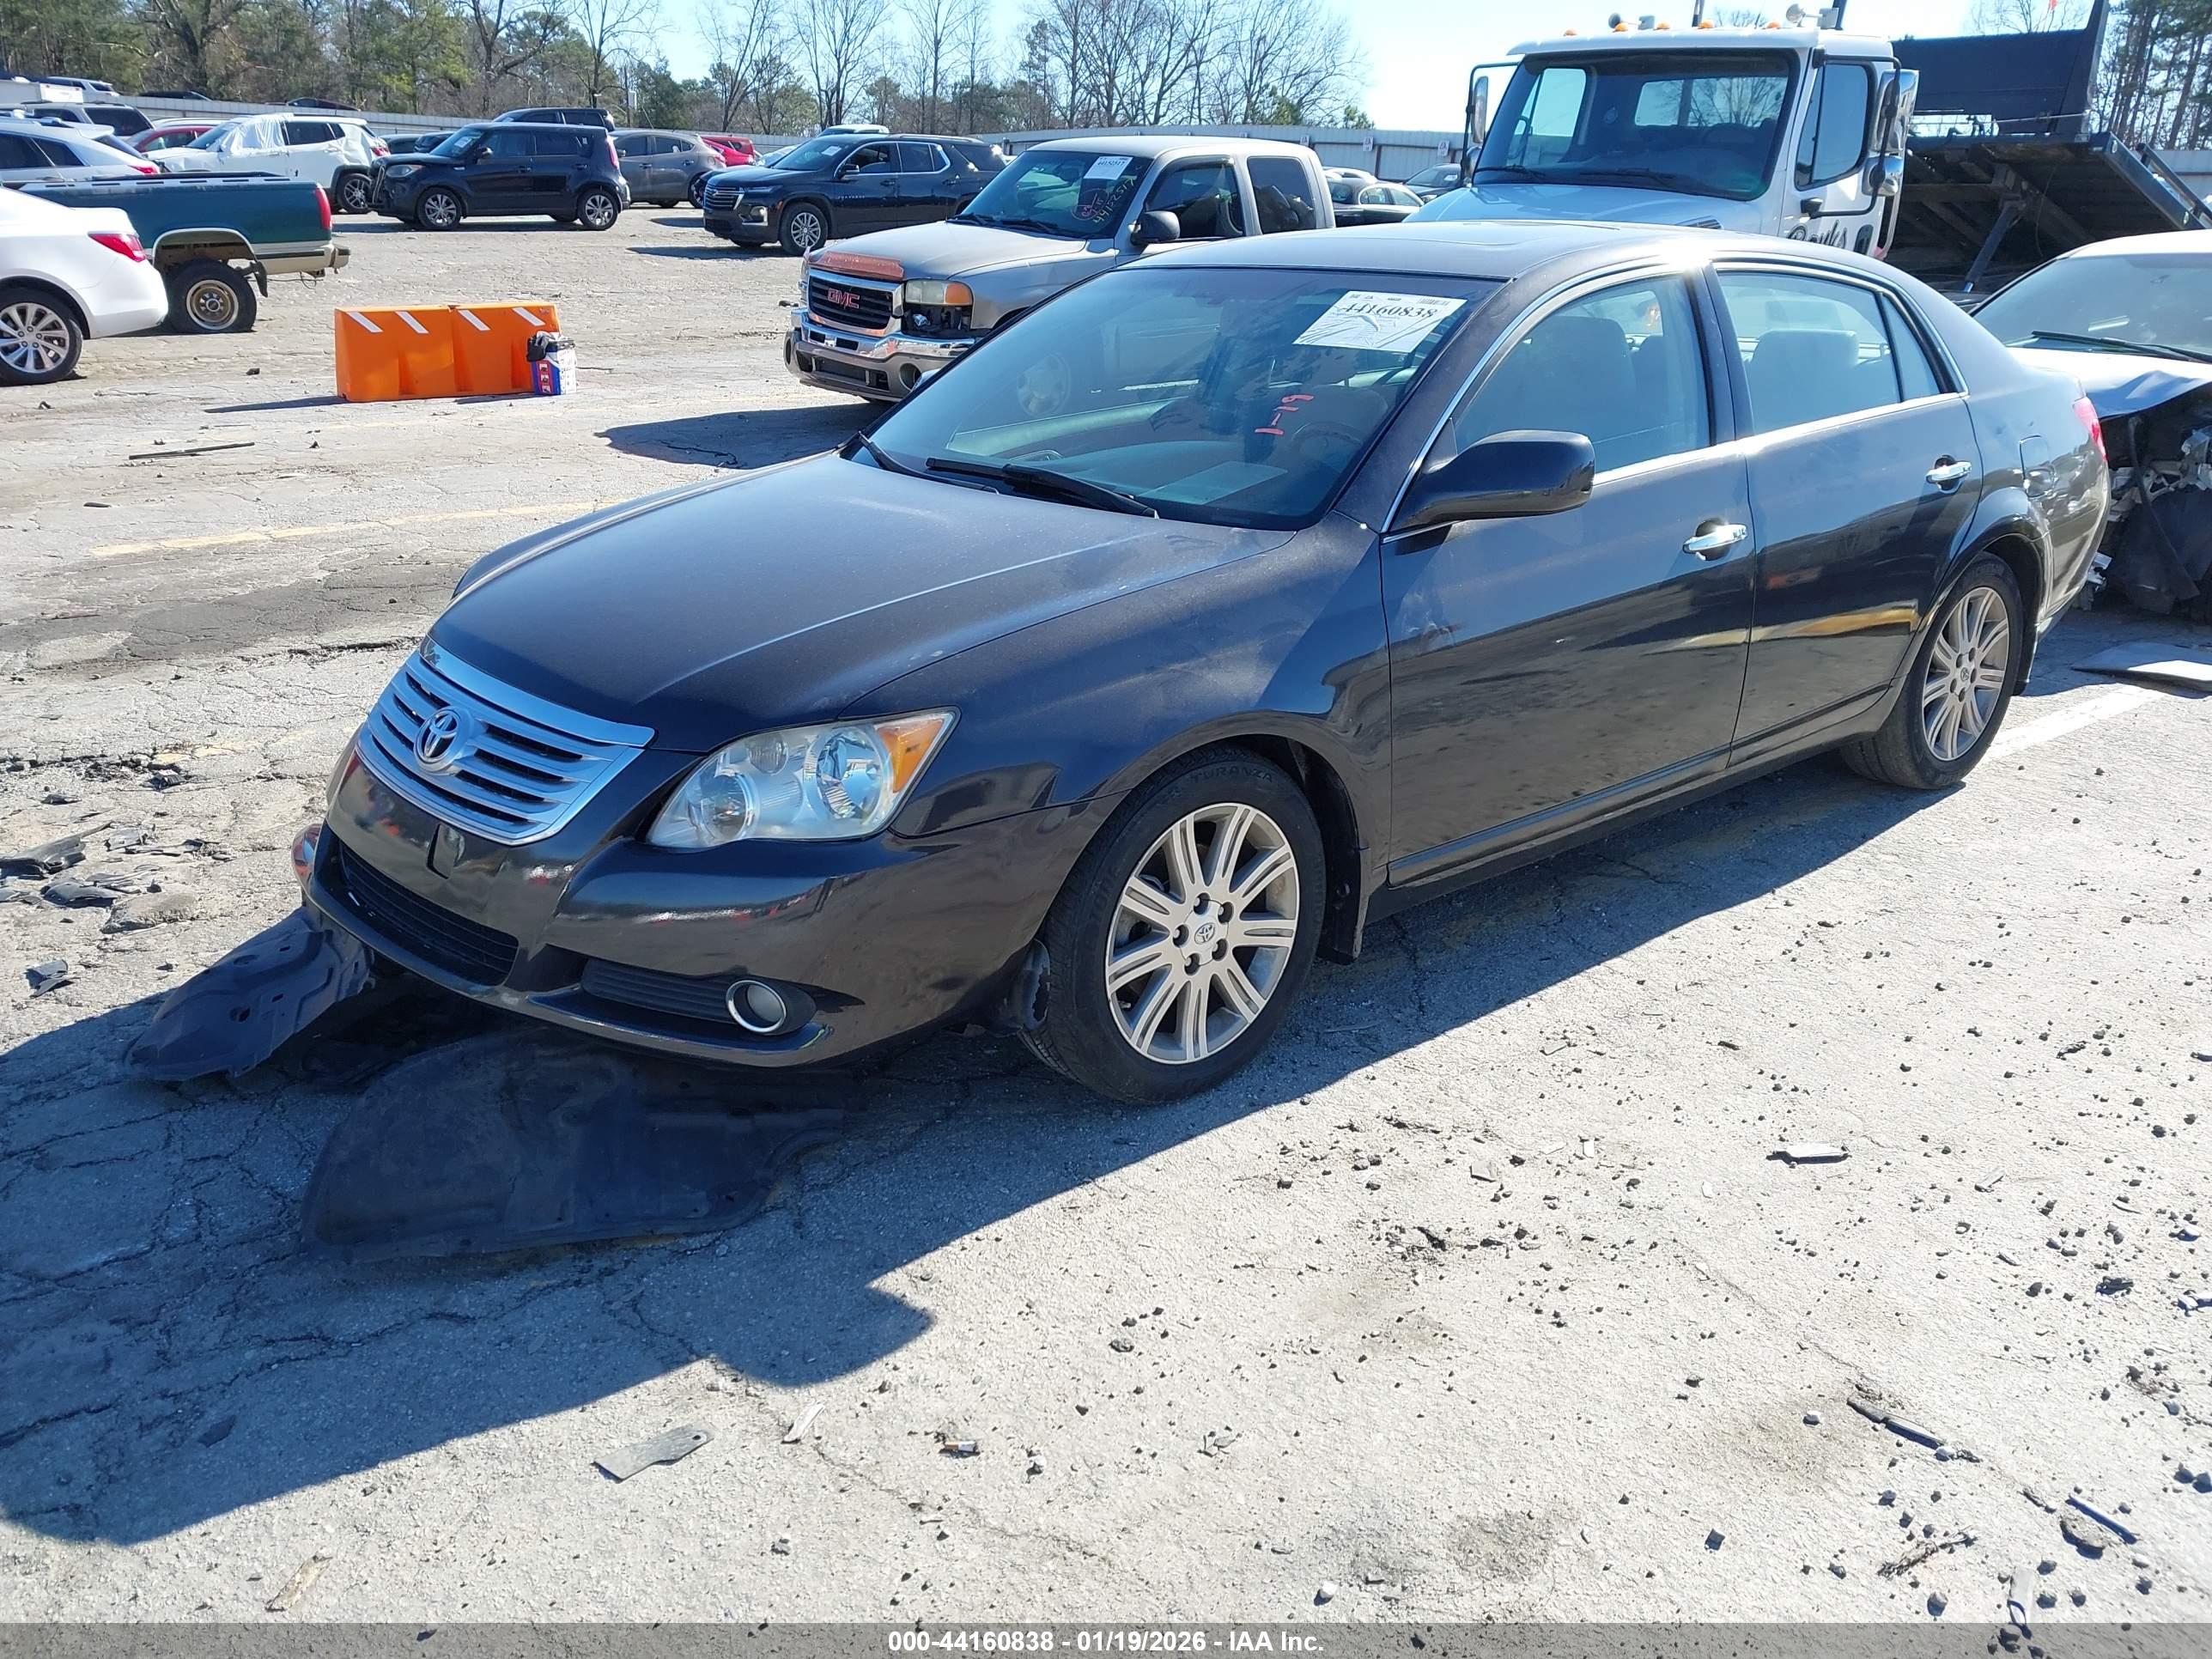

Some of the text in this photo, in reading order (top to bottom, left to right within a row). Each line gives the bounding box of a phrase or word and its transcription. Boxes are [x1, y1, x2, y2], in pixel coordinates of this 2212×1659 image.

[827, 288, 860, 309] GMC
[1342, 302, 1438, 318] 44160838
[1192, 765, 1273, 783] TURANZA
